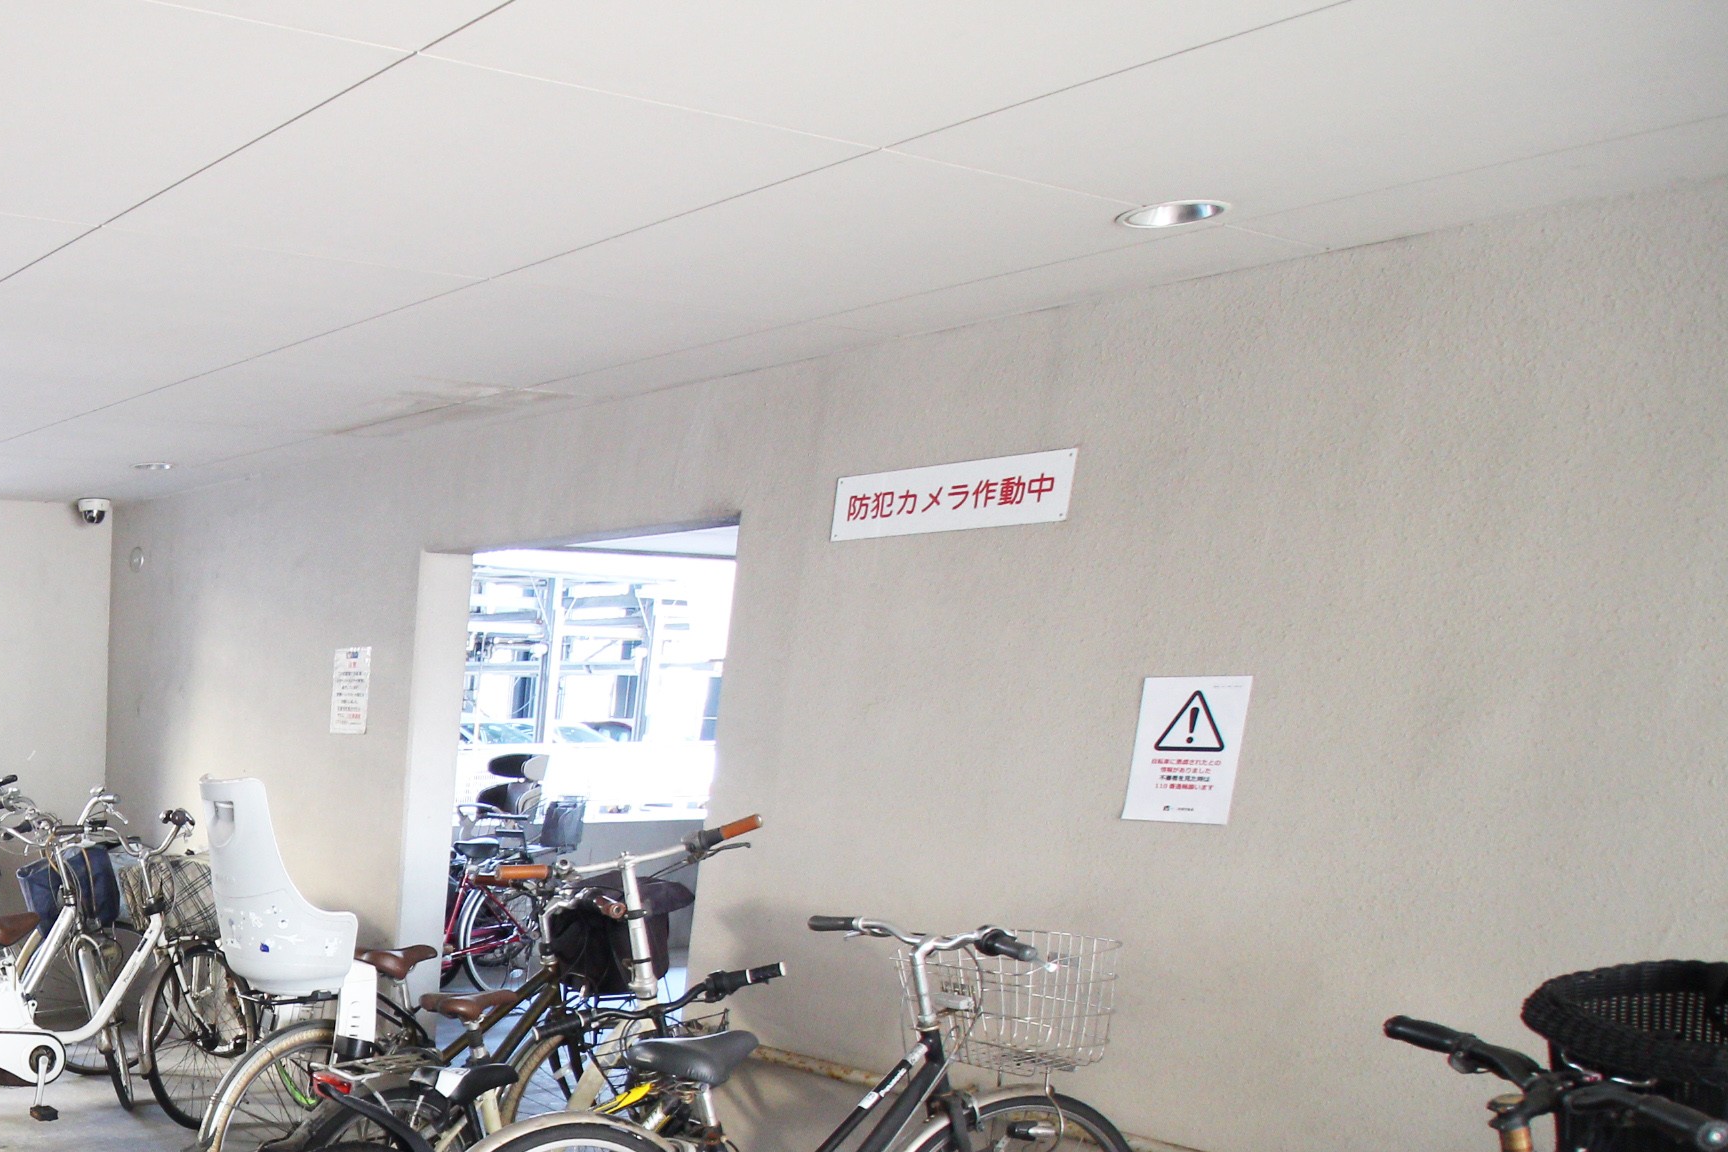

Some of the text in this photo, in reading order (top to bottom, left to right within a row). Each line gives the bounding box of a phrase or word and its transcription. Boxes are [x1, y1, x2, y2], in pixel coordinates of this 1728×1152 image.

[846, 472, 1055, 522] 防犯カメラ作動中
[878, 1067, 908, 1098] Panasonic
